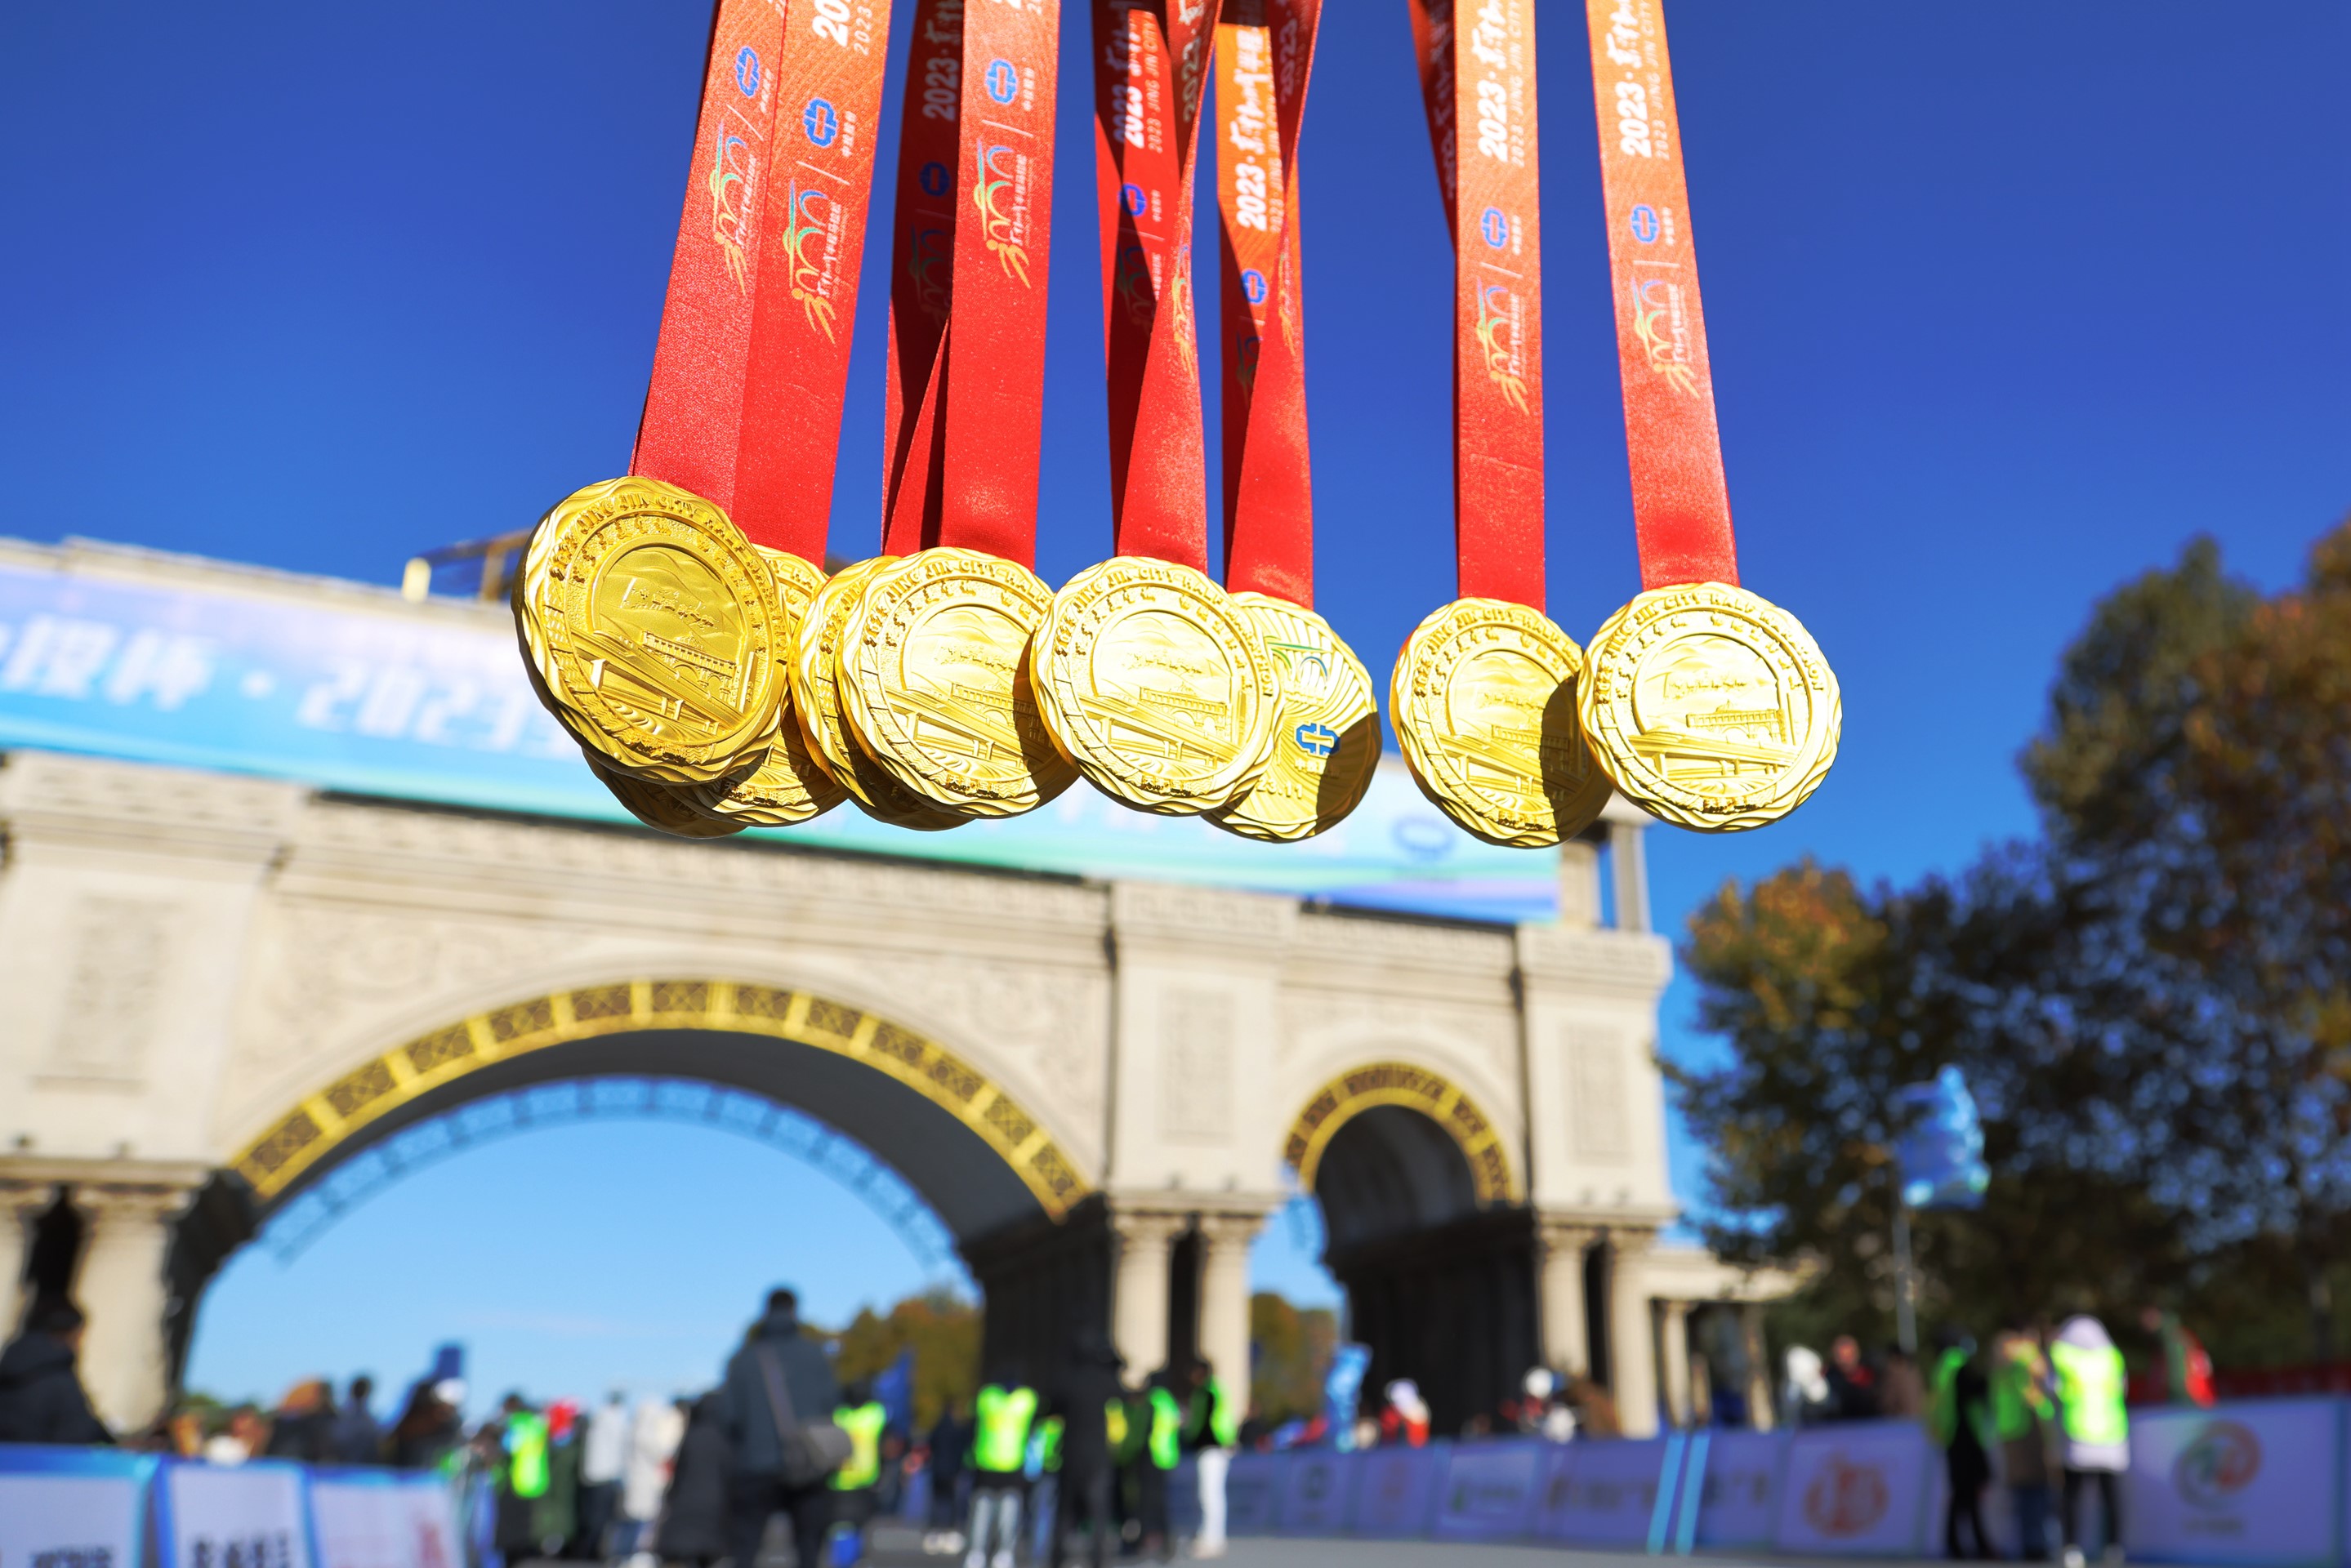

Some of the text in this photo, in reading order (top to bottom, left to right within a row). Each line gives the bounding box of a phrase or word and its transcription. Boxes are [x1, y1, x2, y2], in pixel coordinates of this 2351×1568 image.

[1509, 42, 1523, 72] JIN
[1644, 40, 1659, 69] JIN
[577, 500, 615, 535] JING
[619, 492, 650, 511] JIN
[657, 495, 694, 519] CITY
[703, 512, 746, 553] HALF
[886, 570, 923, 604] JING
[926, 560, 954, 580] JIN
[958, 559, 998, 577] CITY
[1006, 568, 1049, 604] HALF
[1073, 581, 1104, 614] JING
[1107, 570, 1133, 588] JIN
[1137, 566, 1174, 583] CITY
[1182, 575, 1224, 606] HALF
[1427, 621, 1454, 655] JING
[1455, 609, 1479, 630] JIN
[1483, 608, 1515, 622] CITY
[1604, 617, 1635, 659] JING
[1633, 603, 1660, 626] JIN
[1663, 592, 1701, 611] CITY
[1710, 593, 1755, 613] HALF
